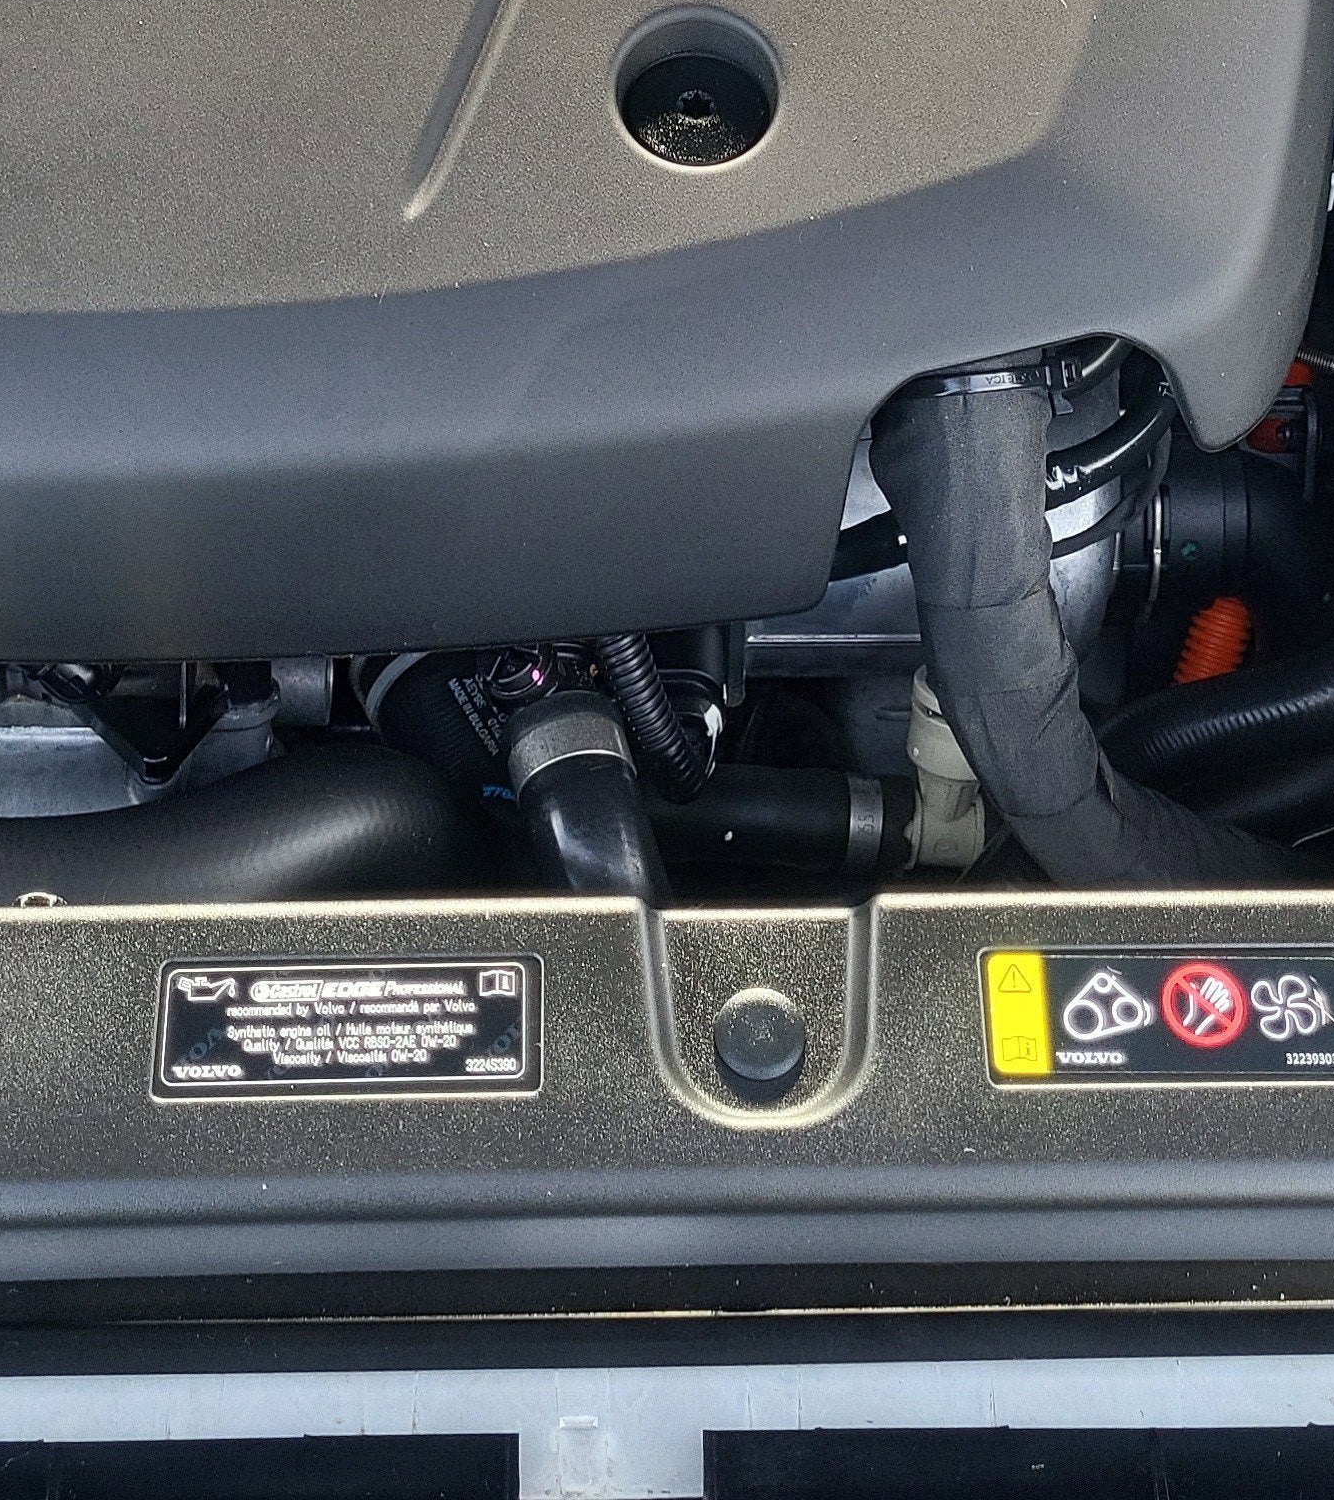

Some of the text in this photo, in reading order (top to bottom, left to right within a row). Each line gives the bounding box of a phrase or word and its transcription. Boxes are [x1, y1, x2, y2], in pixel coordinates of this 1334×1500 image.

[447, 677, 469, 706] MADE
[320, 981, 386, 998] EDGE
[226, 1002, 293, 1017] recommended
[295, 1002, 310, 1018] by
[313, 1001, 346, 1015] Volvo
[422, 1001, 441, 1015] par
[443, 998, 476, 1013] Volvo
[226, 1024, 276, 1041] Synthetic
[279, 1024, 312, 1040] engine
[316, 1022, 332, 1037] oil
[346, 1022, 372, 1036] Huile
[375, 1021, 412, 1035] moteur
[243, 1038, 281, 1053] Quality
[338, 1036, 361, 1050] VCC
[272, 1051, 322, 1067] Viscosity
[465, 1057, 517, 1072] 32245390
[1055, 1051, 1124, 1065] VOLVO
[172, 1064, 243, 1079] VOLVO
